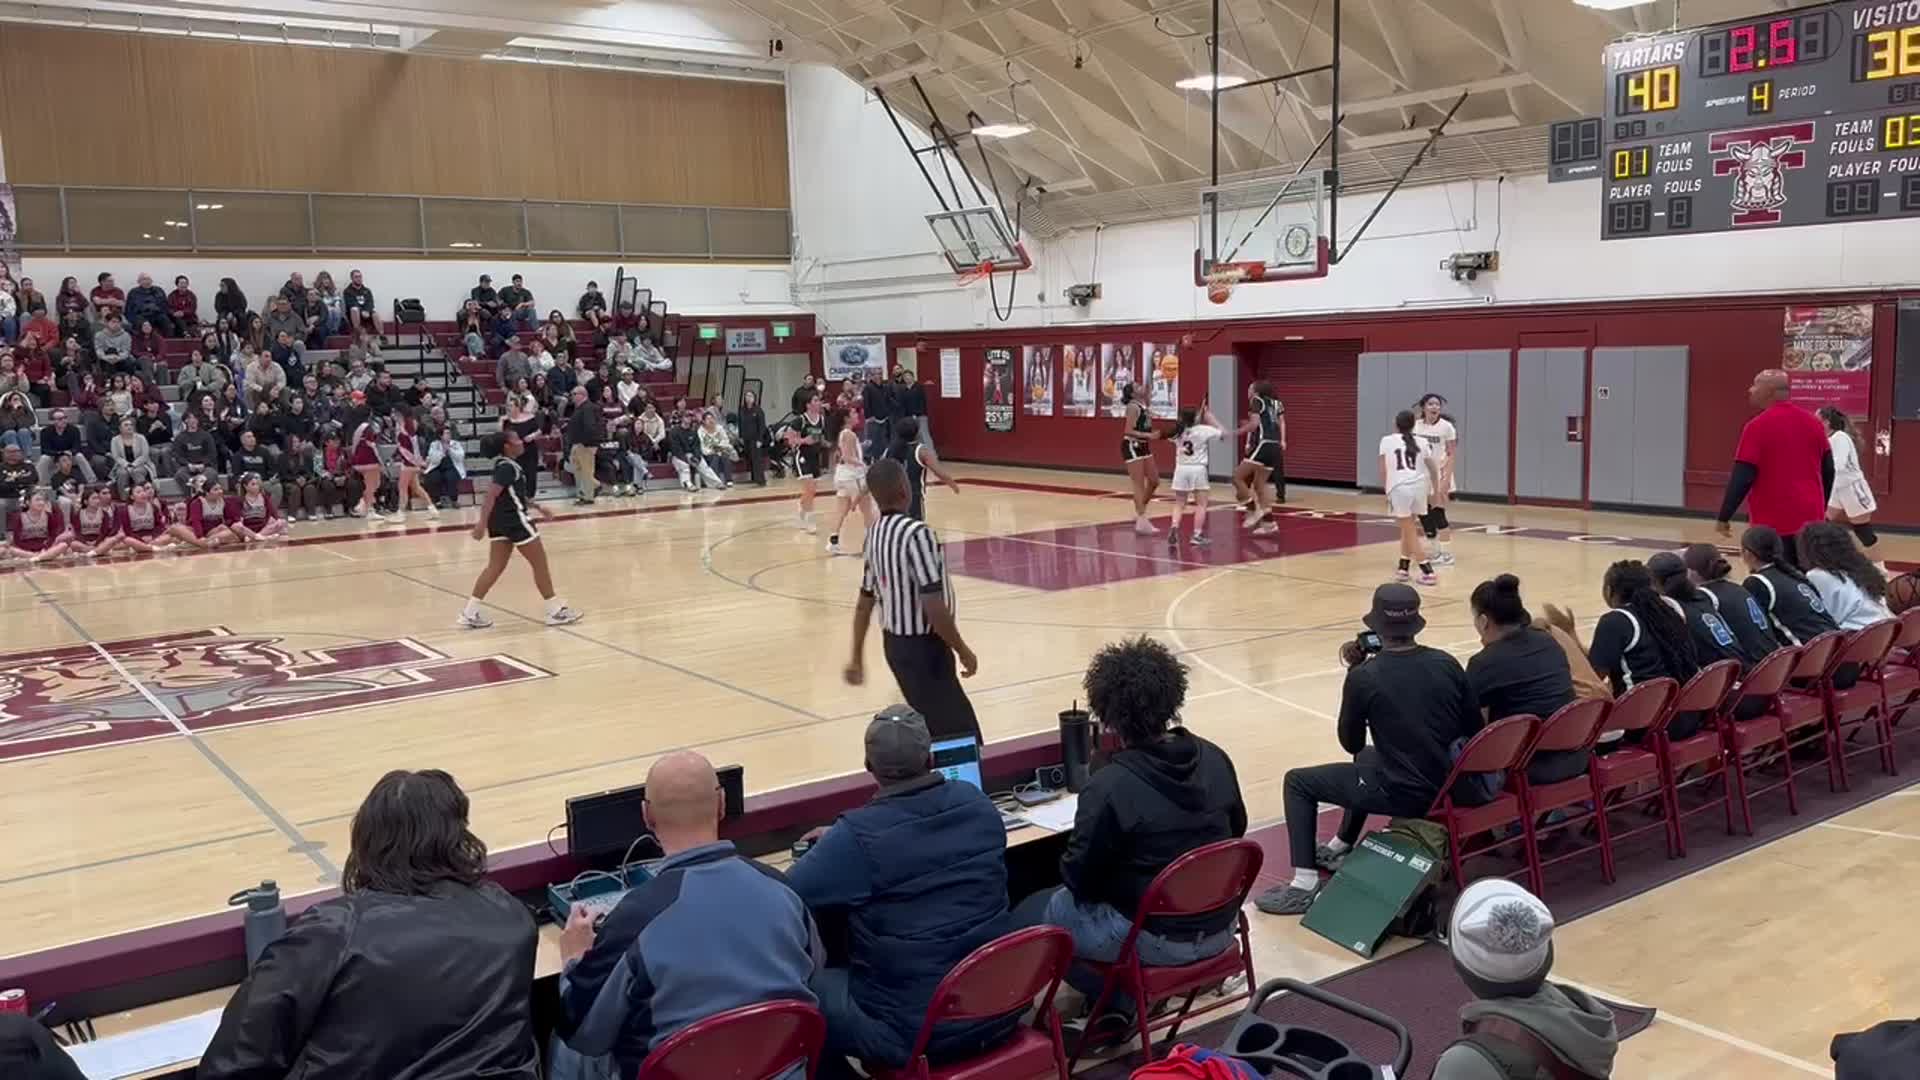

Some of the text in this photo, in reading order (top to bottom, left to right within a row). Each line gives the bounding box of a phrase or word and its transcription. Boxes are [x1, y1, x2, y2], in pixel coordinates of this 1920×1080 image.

[1730, 19, 1797, 72] 2.5
[1613, 42, 1685, 70] TARTARS
[1628, 66, 1677, 111] 40
[1752, 82, 1769, 111] 4
[1778, 85, 1816, 99] PERIOD
[1835, 120, 1873, 136] TEAM
[1659, 141, 1692, 157] TEAM
[1829, 138, 1875, 156] FOULS
[1615, 148, 1648, 178] 01
[1656, 158, 1693, 174] FOULS
[1828, 156, 1920, 179] PLAYER FOU
[1609, 179, 1702, 199] PLAYER FOULS
[1183, 440, 1194, 456] 3
